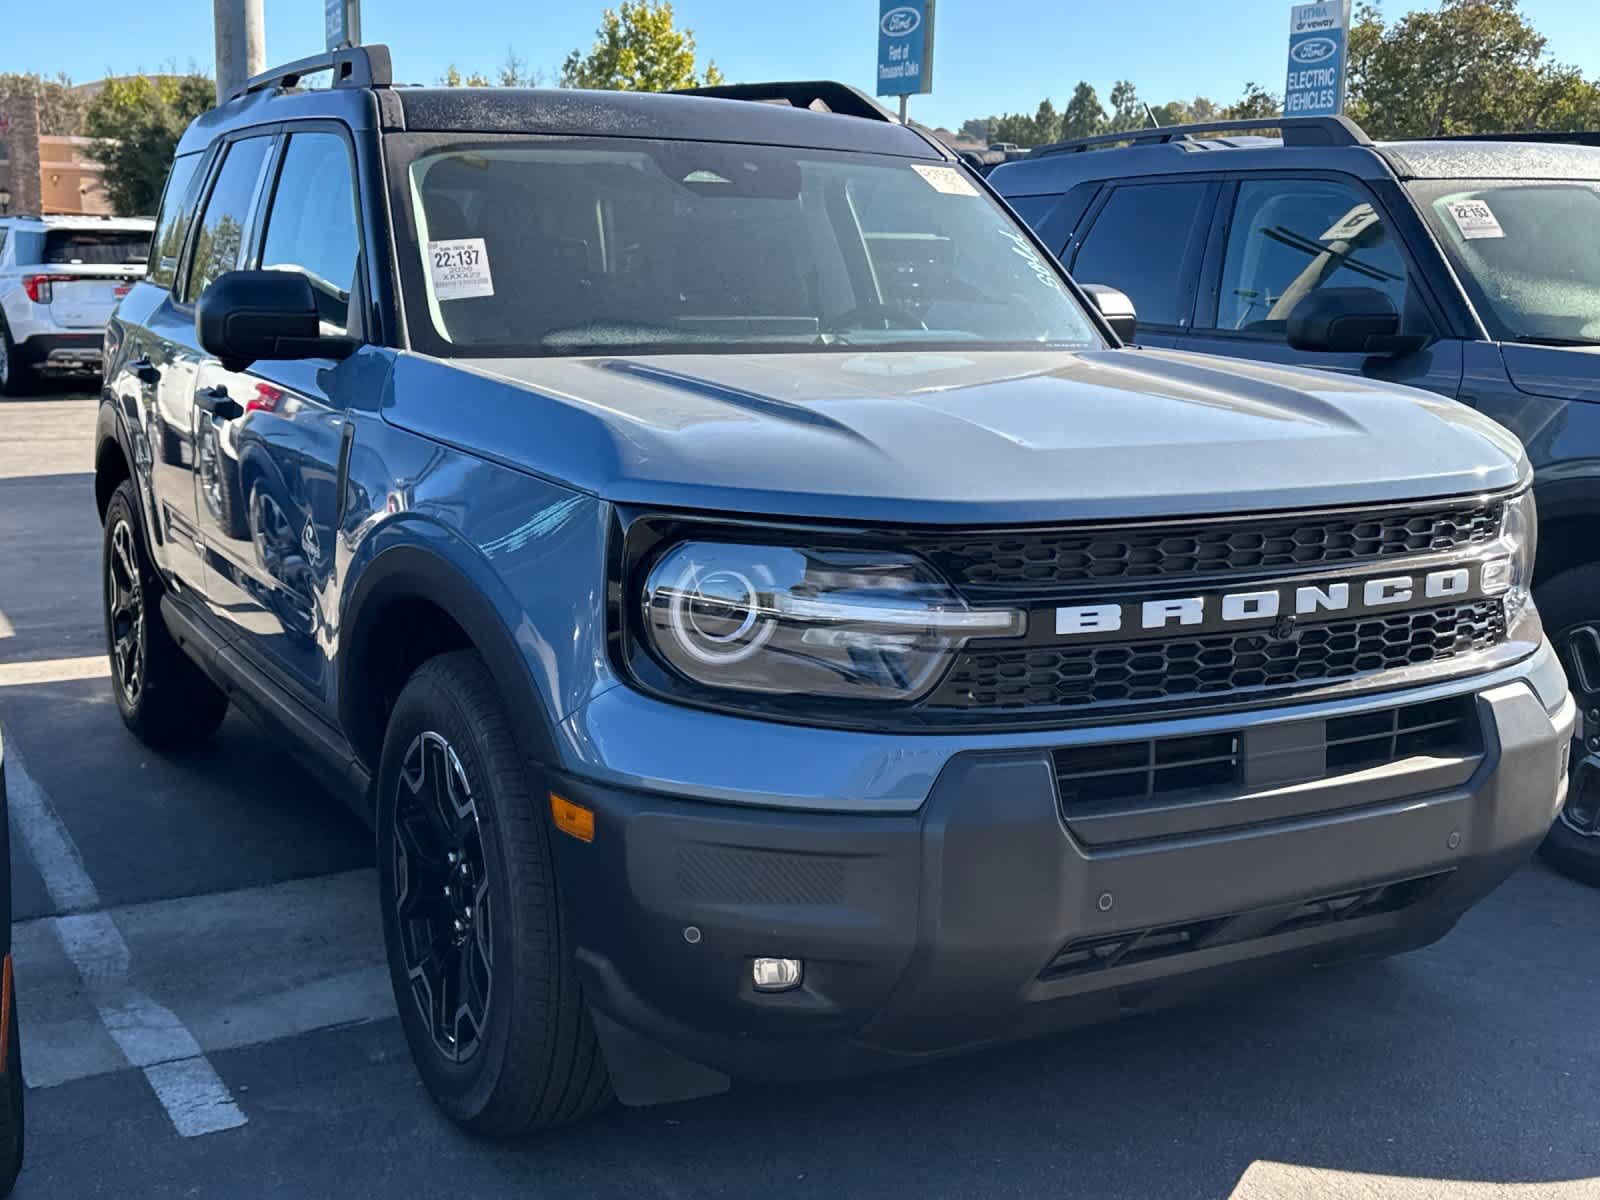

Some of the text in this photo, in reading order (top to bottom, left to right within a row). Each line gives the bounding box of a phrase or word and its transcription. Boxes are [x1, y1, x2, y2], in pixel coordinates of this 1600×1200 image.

[888, 13, 912, 31] Ford
[1296, 18, 1334, 30] drveway
[1300, 43, 1328, 58] Ford
[1288, 67, 1335, 90] ELECTRIC
[1287, 90, 1334, 112] VEHICLES
[434, 250, 480, 268] 22:137
[1056, 568, 1470, 635] BRONCO
